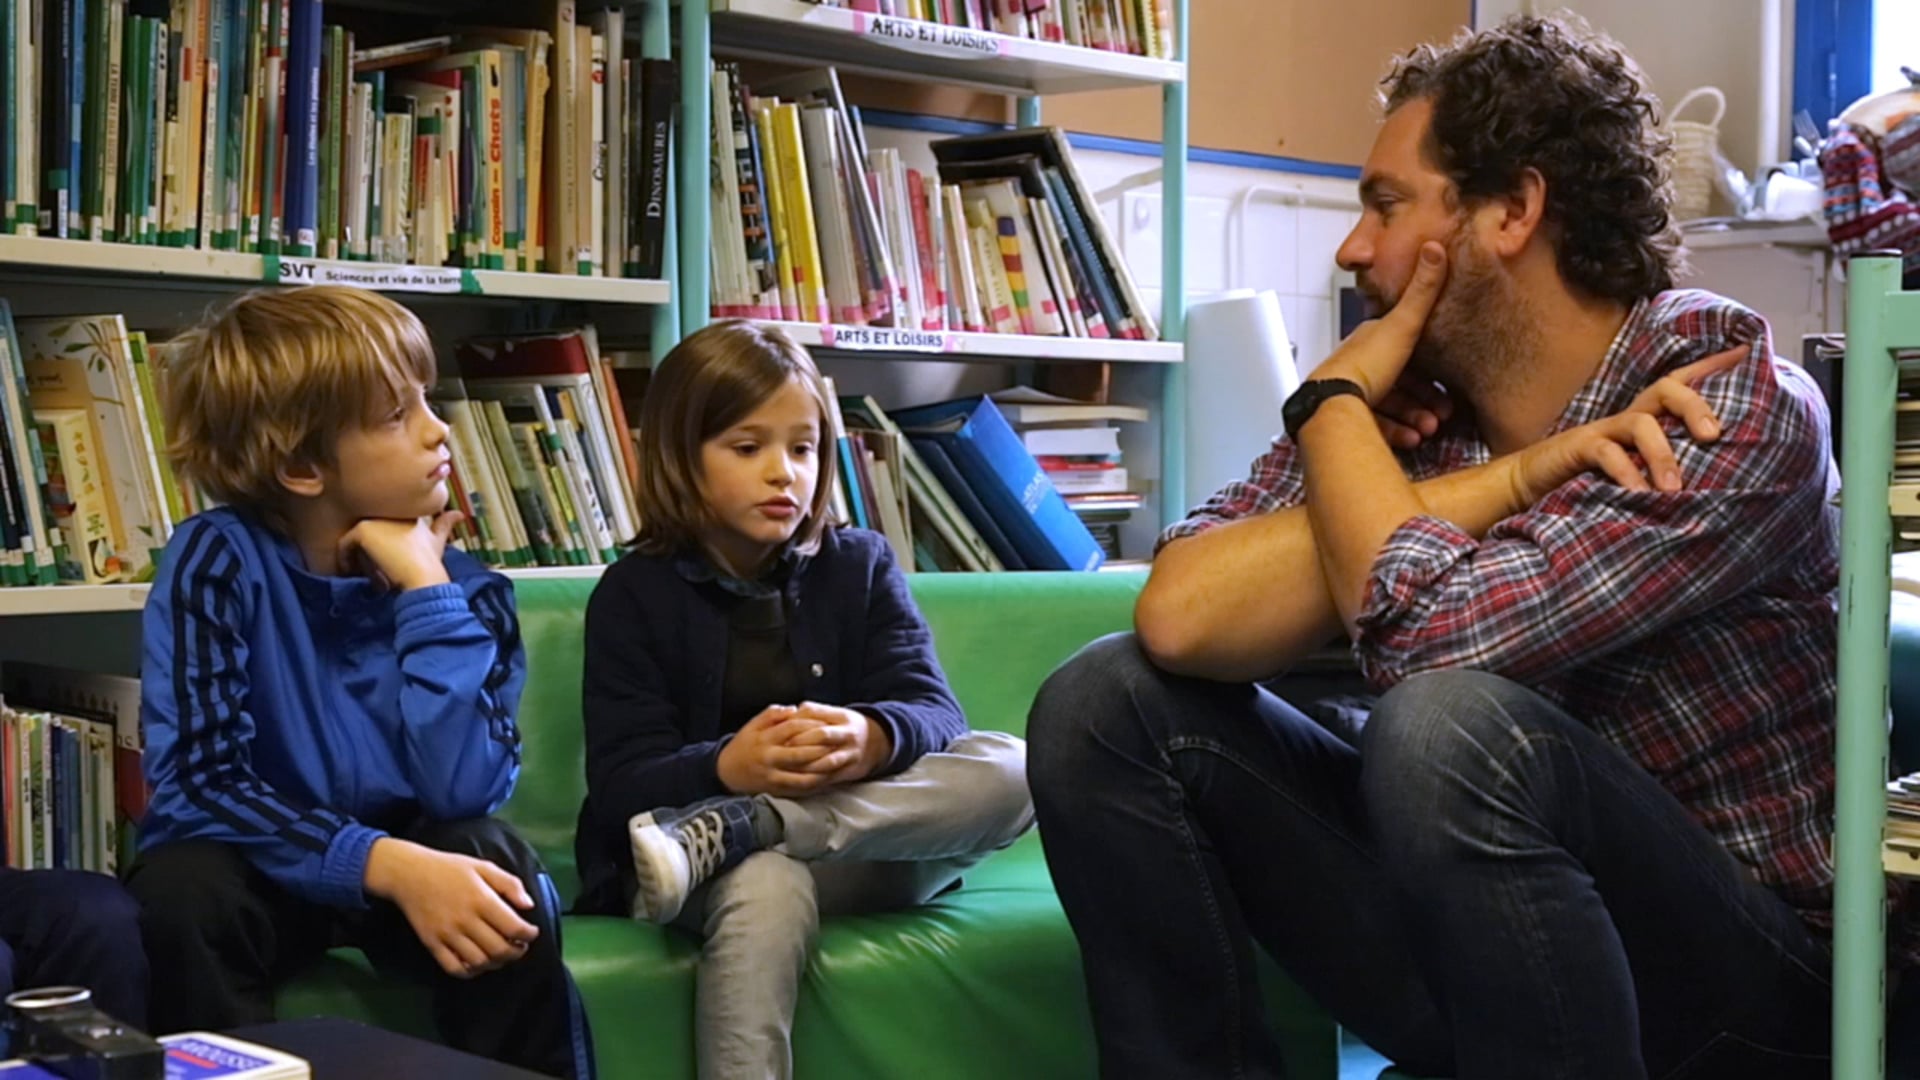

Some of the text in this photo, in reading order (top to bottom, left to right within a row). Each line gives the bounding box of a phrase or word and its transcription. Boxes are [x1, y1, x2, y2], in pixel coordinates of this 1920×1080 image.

[871, 17, 999, 53] ARTS ET LOISIRS
[490, 98, 501, 162] Chats
[647, 121, 666, 217] DINOSAURES
[280, 262, 315, 279] SVT
[326, 271, 375, 284] Sciences
[378, 277, 389, 285] et
[392, 276, 408, 285] vie
[411, 276, 423, 285] de
[426, 276, 436, 285] la
[835, 330, 943, 347] ARTS ET LOISIRS
